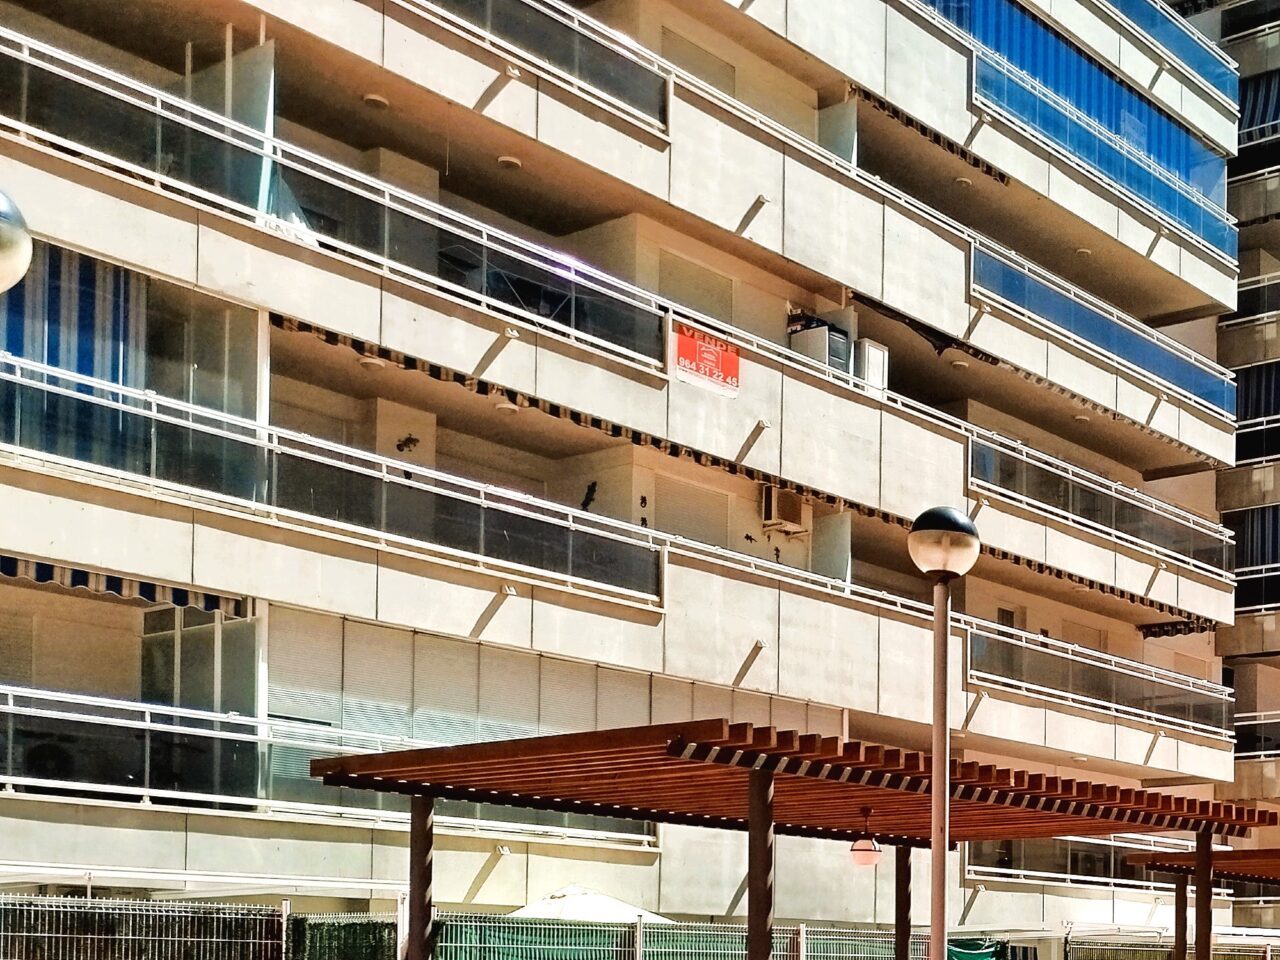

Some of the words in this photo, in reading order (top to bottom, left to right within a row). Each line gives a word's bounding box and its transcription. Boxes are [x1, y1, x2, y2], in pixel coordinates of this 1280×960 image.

[682, 326, 737, 353] VENDE
[679, 357, 697, 370] 964
[699, 365, 710, 376] 31
[713, 370, 724, 381] 22
[726, 376, 737, 386] 45
